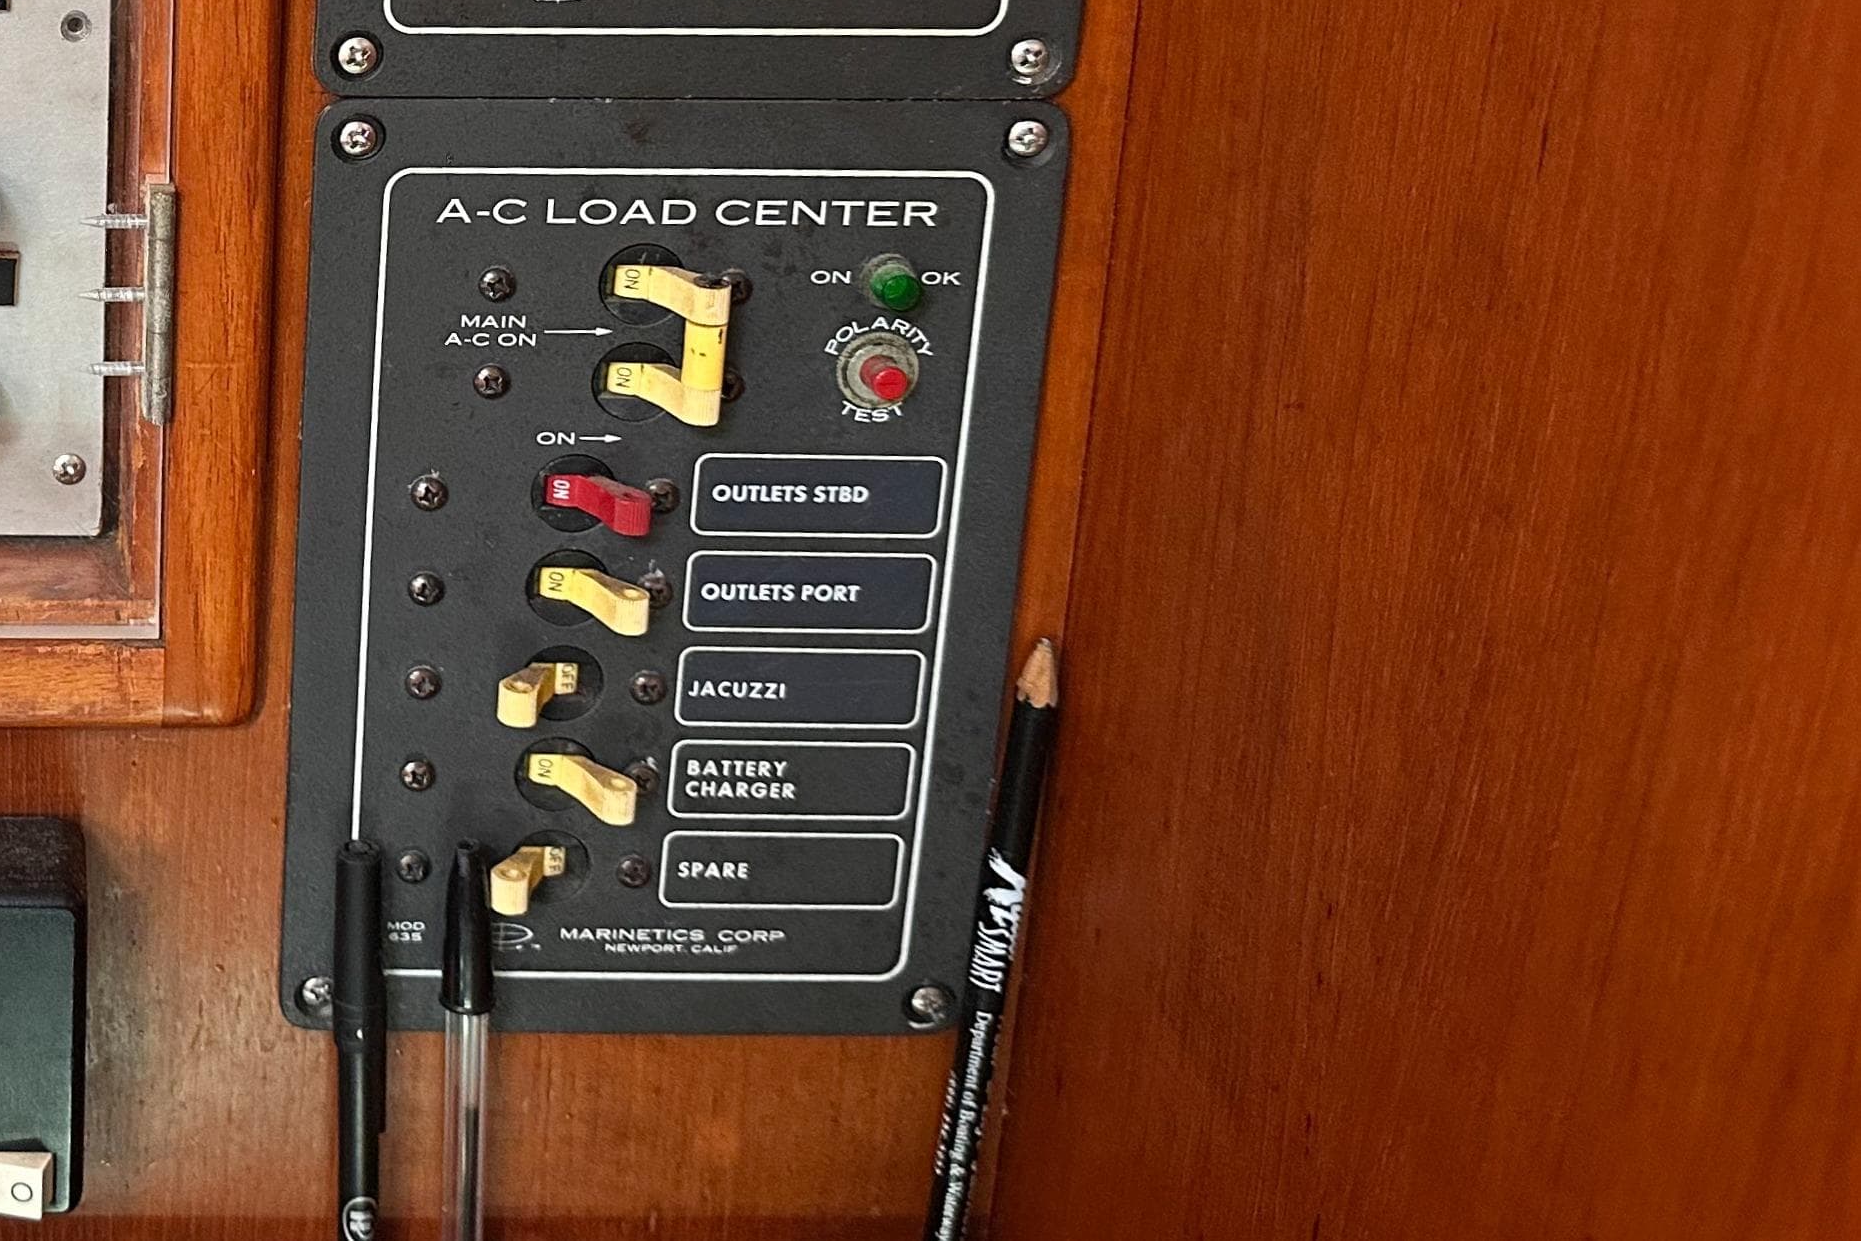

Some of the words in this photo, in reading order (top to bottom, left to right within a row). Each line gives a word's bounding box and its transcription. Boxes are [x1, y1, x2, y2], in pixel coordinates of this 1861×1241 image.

[436, 198, 528, 224] A-C
[546, 199, 697, 225] LOAD
[715, 200, 939, 227] CENTER
[624, 268, 641, 290] ON
[809, 270, 851, 285] ON
[921, 271, 961, 285] OK
[460, 315, 528, 329] MAIN
[444, 332, 490, 347] A-C
[497, 333, 537, 347] ON
[824, 316, 934, 356] POLARITY
[616, 367, 632, 388] ON
[841, 400, 903, 423] TEST
[536, 431, 576, 445] ON
[553, 479, 571, 500] ON
[712, 483, 808, 503] OUTLETS
[812, 484, 869, 504] STBD
[548, 571, 565, 592] ON
[700, 583, 796, 602] OUTLETS
[800, 583, 860, 603] PORT
[561, 664, 575, 693] OFF
[687, 680, 787, 700] JACUZZI
[538, 759, 553, 780] ON
[686, 759, 787, 778] BATTERY
[684, 780, 796, 800] CHARGER
[548, 846, 563, 873] OFF
[677, 861, 751, 880] SPARE
[387, 921, 425, 931] MOD
[560, 927, 705, 942] MARINETICS
[717, 929, 786, 943] CORP
[963, 1010, 993, 1090] Department
[961, 1091, 977, 1108] of
[949, 1109, 976, 1162] Boating
